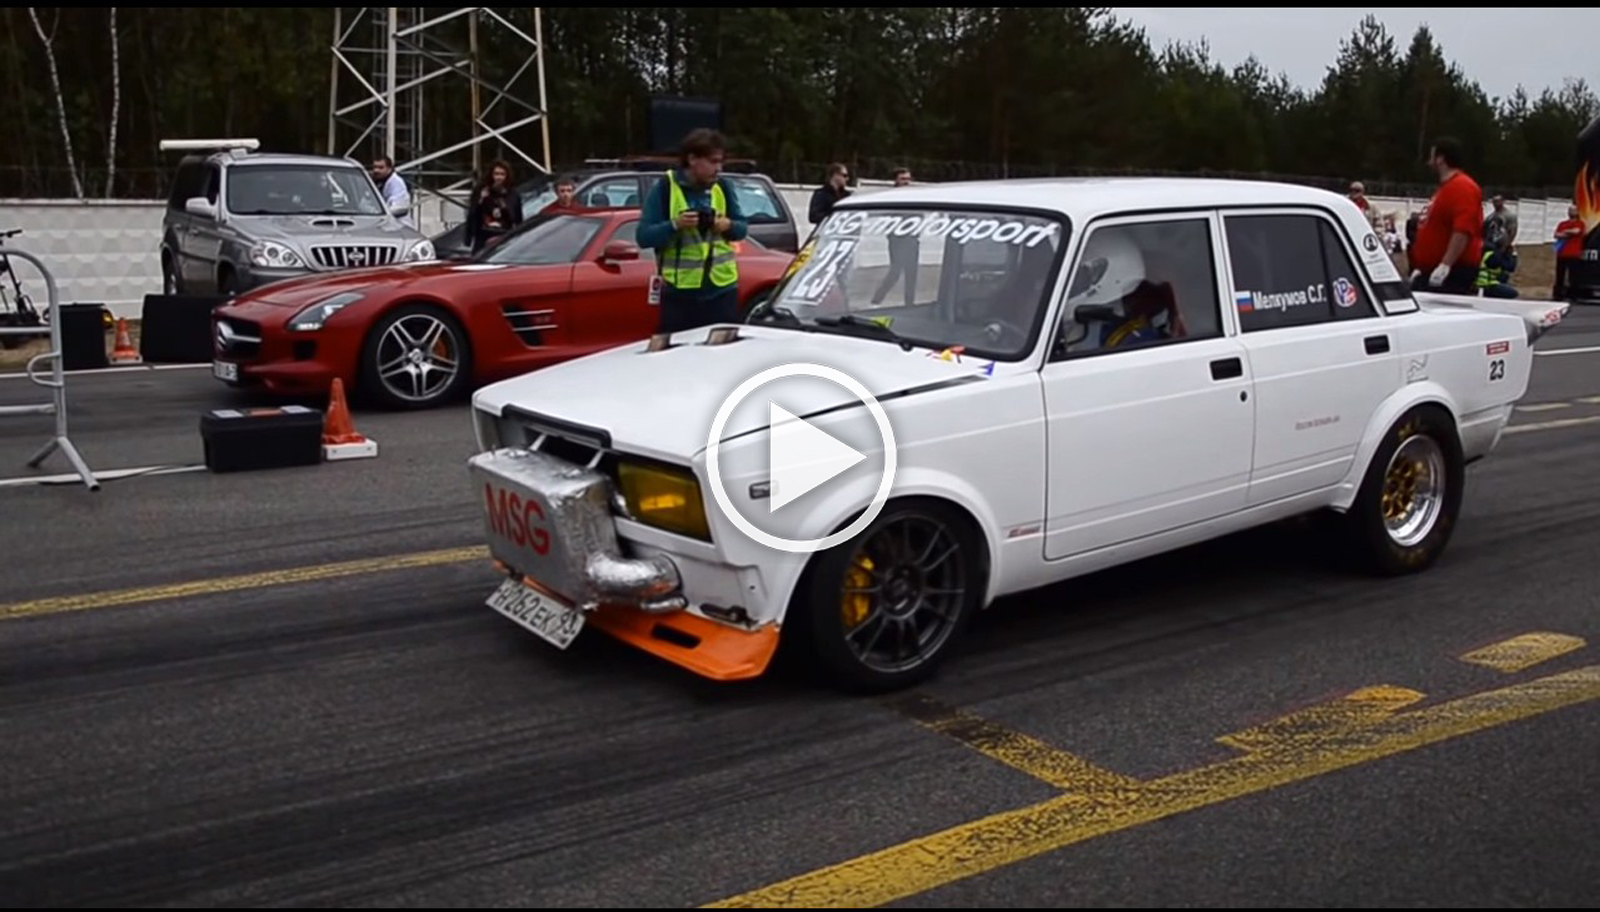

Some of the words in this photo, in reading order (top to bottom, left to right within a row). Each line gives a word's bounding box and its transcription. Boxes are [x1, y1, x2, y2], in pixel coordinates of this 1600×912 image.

[791, 240, 855, 298] 23
[1252, 290, 1307, 312] Мелкумов
[1489, 359, 1505, 381] 23
[484, 482, 551, 556] MSG
